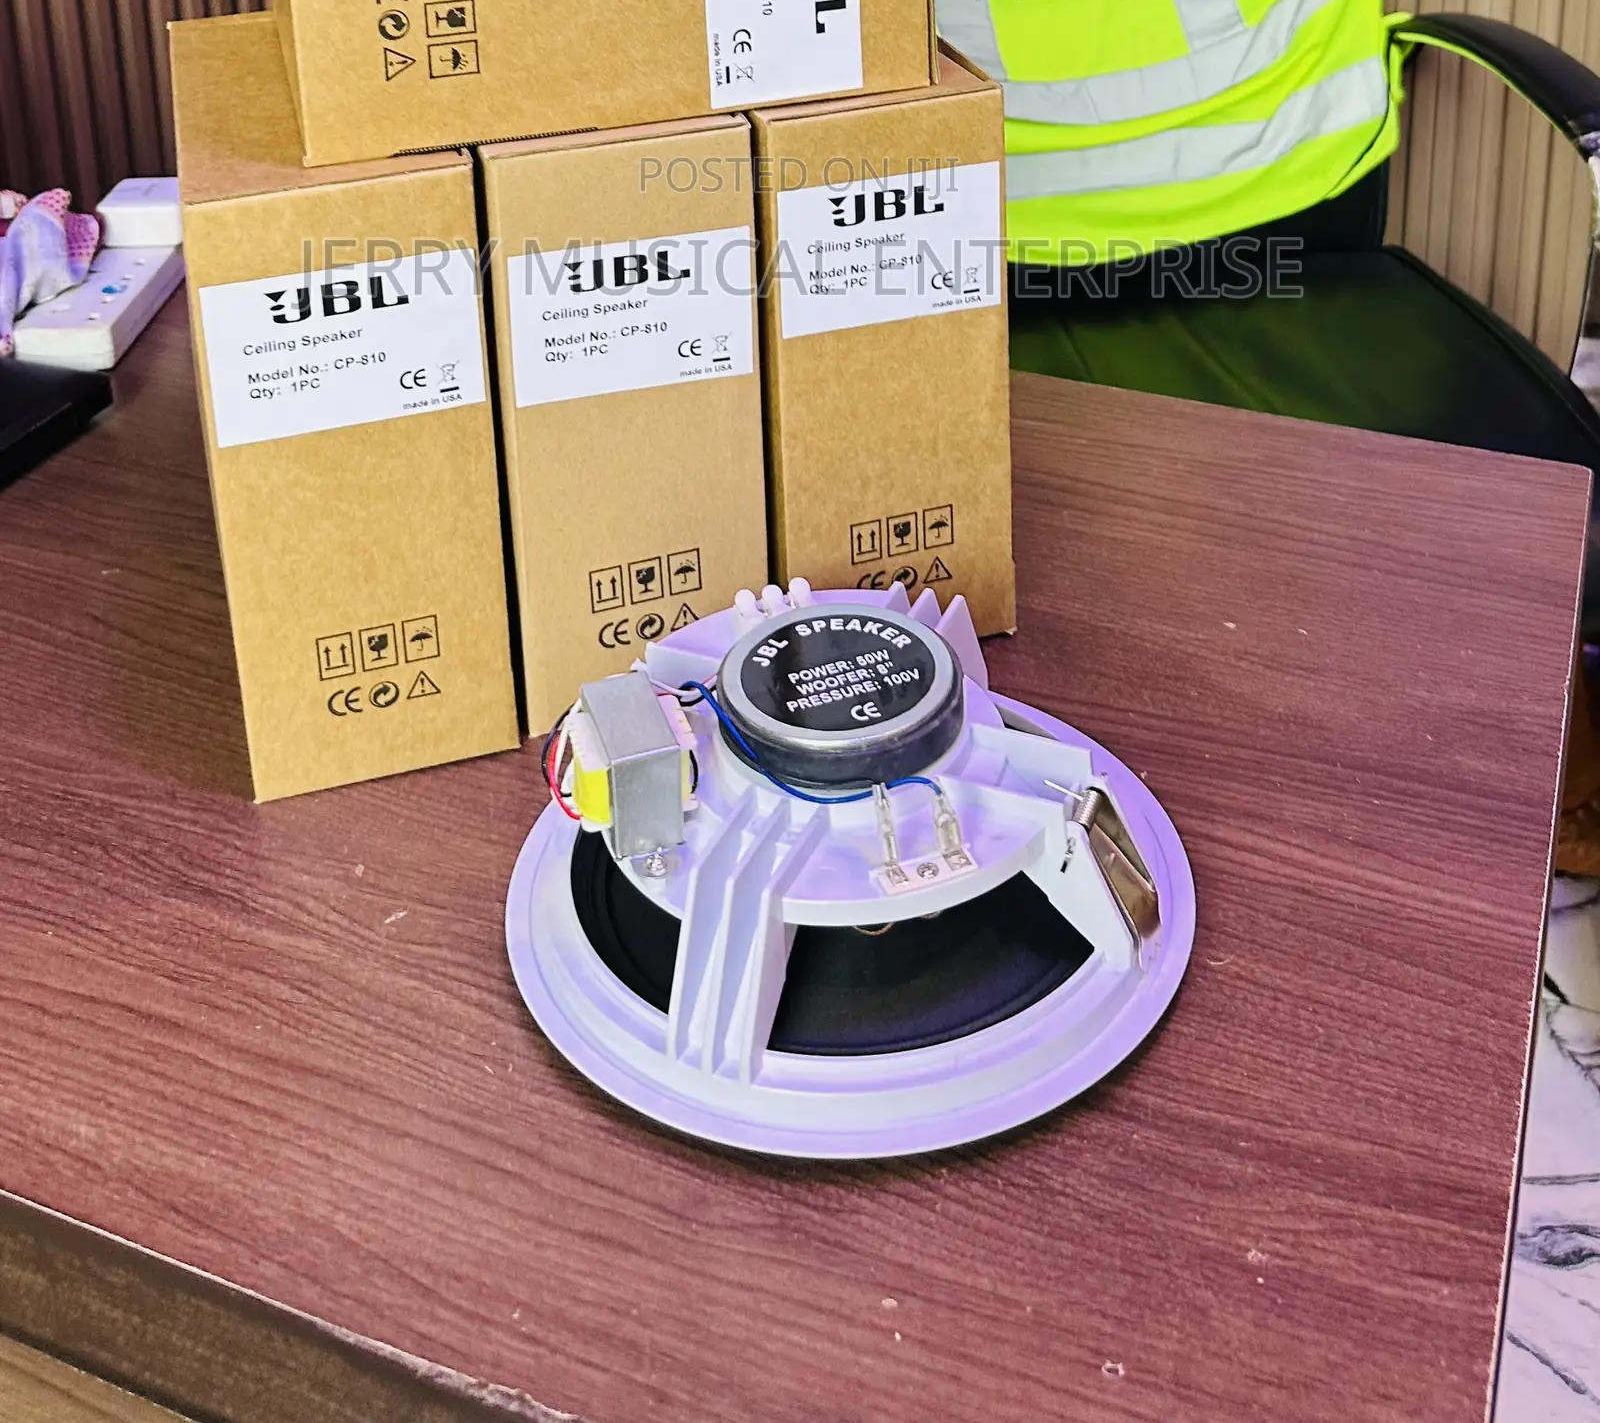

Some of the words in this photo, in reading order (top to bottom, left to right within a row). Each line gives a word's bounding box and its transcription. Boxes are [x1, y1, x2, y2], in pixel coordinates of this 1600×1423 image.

[714, 58, 721, 66] in
[831, 185, 945, 227] JBL
[807, 240, 850, 255] Ceiling
[854, 232, 905, 251] Speaker
[566, 250, 691, 293] JBL
[809, 267, 847, 281] Model
[850, 262, 874, 274] No.:
[809, 282, 835, 295] Qty:
[842, 276, 868, 289] 1PC
[267, 275, 410, 325] JBL
[542, 305, 589, 322] Ceiling
[593, 298, 648, 316] Speaker
[932, 299, 953, 309] made
[955, 297, 962, 305] in
[965, 295, 982, 304] USA
[243, 338, 296, 357] Ceiling
[302, 328, 363, 348] Speaker
[544, 333, 585, 348] Model
[590, 329, 616, 343] No.:
[620, 321, 667, 338] CP-810
[545, 350, 573, 363] Qty:
[581, 344, 609, 357] 1PC
[248, 366, 294, 384] Model
[299, 362, 328, 379] No.:
[333, 351, 387, 371] CP-810
[680, 368, 702, 377] made
[704, 365, 712, 373] in
[715, 363, 732, 372] USA
[250, 386, 281, 400] Qty:
[290, 378, 320, 393] 1PC
[403, 400, 428, 410] made
[431, 397, 440, 405] in
[442, 393, 463, 403] USA
[752, 637, 790, 668] JBL
[794, 618, 912, 649] SPEAKER
[787, 659, 855, 684] POWER:
[795, 668, 875, 696] WOOFER:
[786, 679, 881, 713] PRESSURE:
[883, 668, 920, 688] 100V
